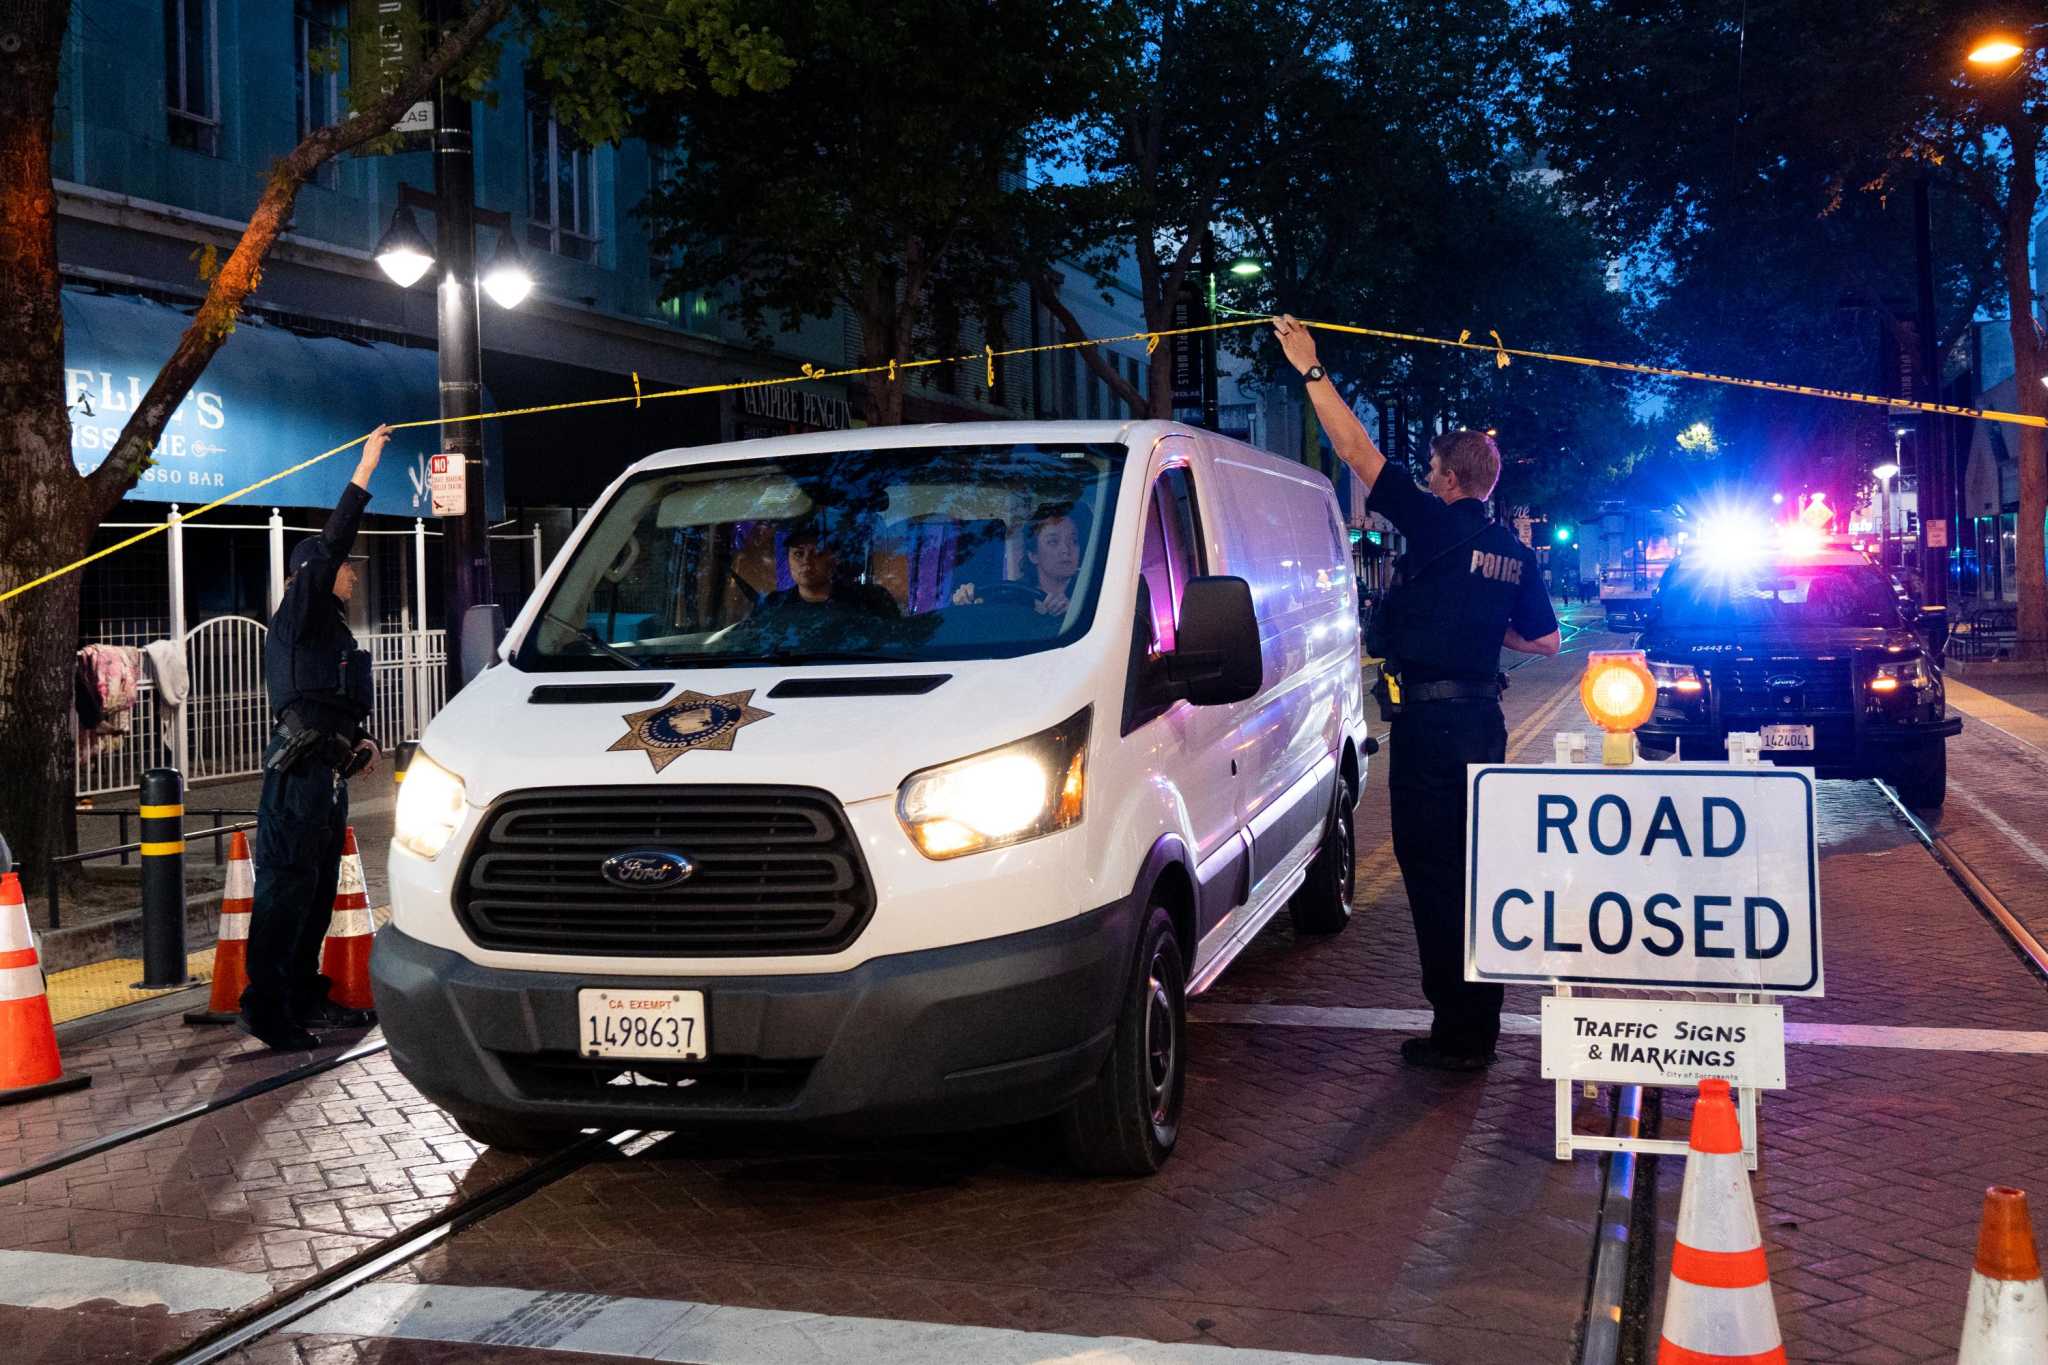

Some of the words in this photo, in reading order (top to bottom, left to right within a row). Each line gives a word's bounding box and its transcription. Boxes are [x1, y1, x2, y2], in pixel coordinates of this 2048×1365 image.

[743, 380, 799, 422] VAMPIRE
[802, 391, 854, 430] PENGUIN
[434, 458, 446, 471] NO
[188, 471, 225, 487] BAR
[1470, 549, 1523, 585] POLICE
[690, 720, 736, 745] COUNTY
[1764, 734, 1811, 746] 1424041
[1536, 794, 1747, 858] ROAD
[618, 858, 672, 881] Ford
[1491, 888, 1790, 960] CLOSED
[608, 1000, 625, 1009] CA
[629, 1000, 673, 1010] EXEMPT
[589, 1015, 695, 1048] 1498637
[1588, 1044, 1602, 1060] &
